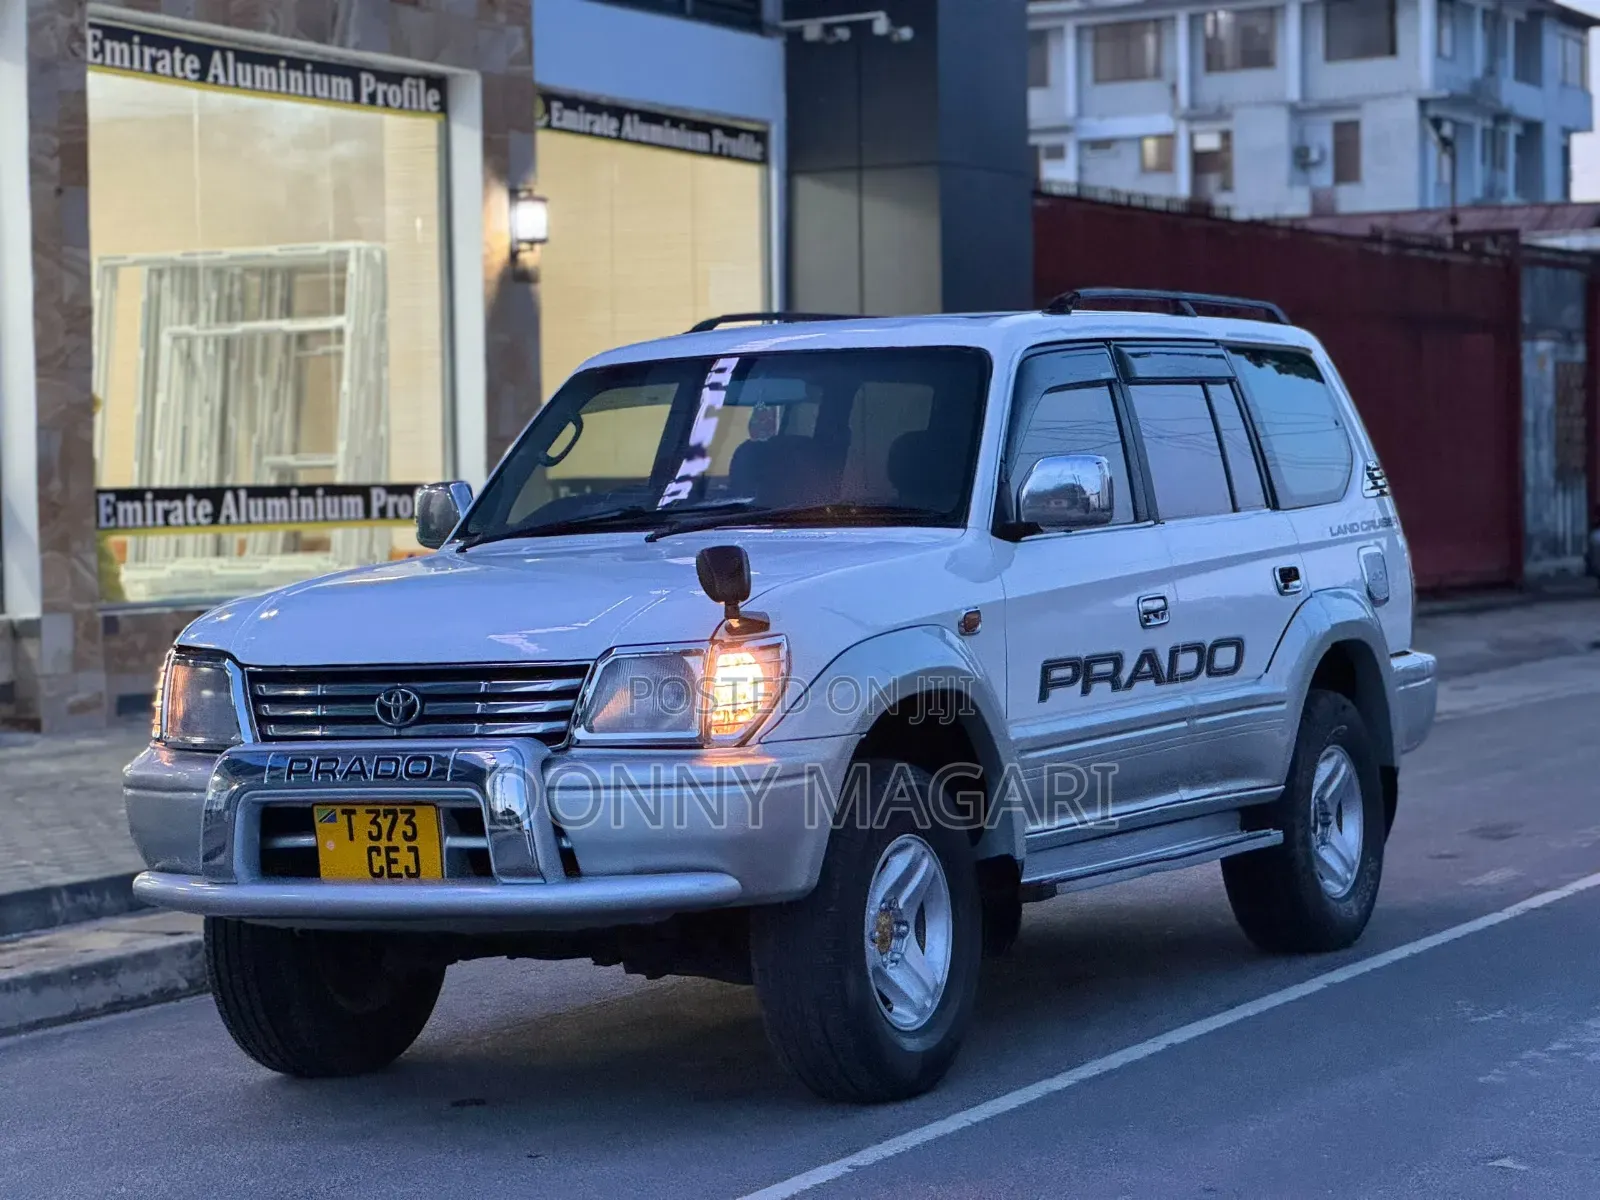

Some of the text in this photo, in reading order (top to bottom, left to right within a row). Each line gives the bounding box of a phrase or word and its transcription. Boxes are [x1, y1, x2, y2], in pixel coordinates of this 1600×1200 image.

[87, 28, 441, 112] Emirate Aluminium Profile
[550, 100, 763, 161] Emirate Aluminium Profile
[97, 486, 416, 528] Emirate Aluminium Pro
[1329, 522, 1360, 537] LAND
[1037, 635, 1246, 704] PRADO
[284, 755, 434, 782] PRADO
[341, 808, 418, 843] T 373
[366, 845, 421, 879] CEJ
